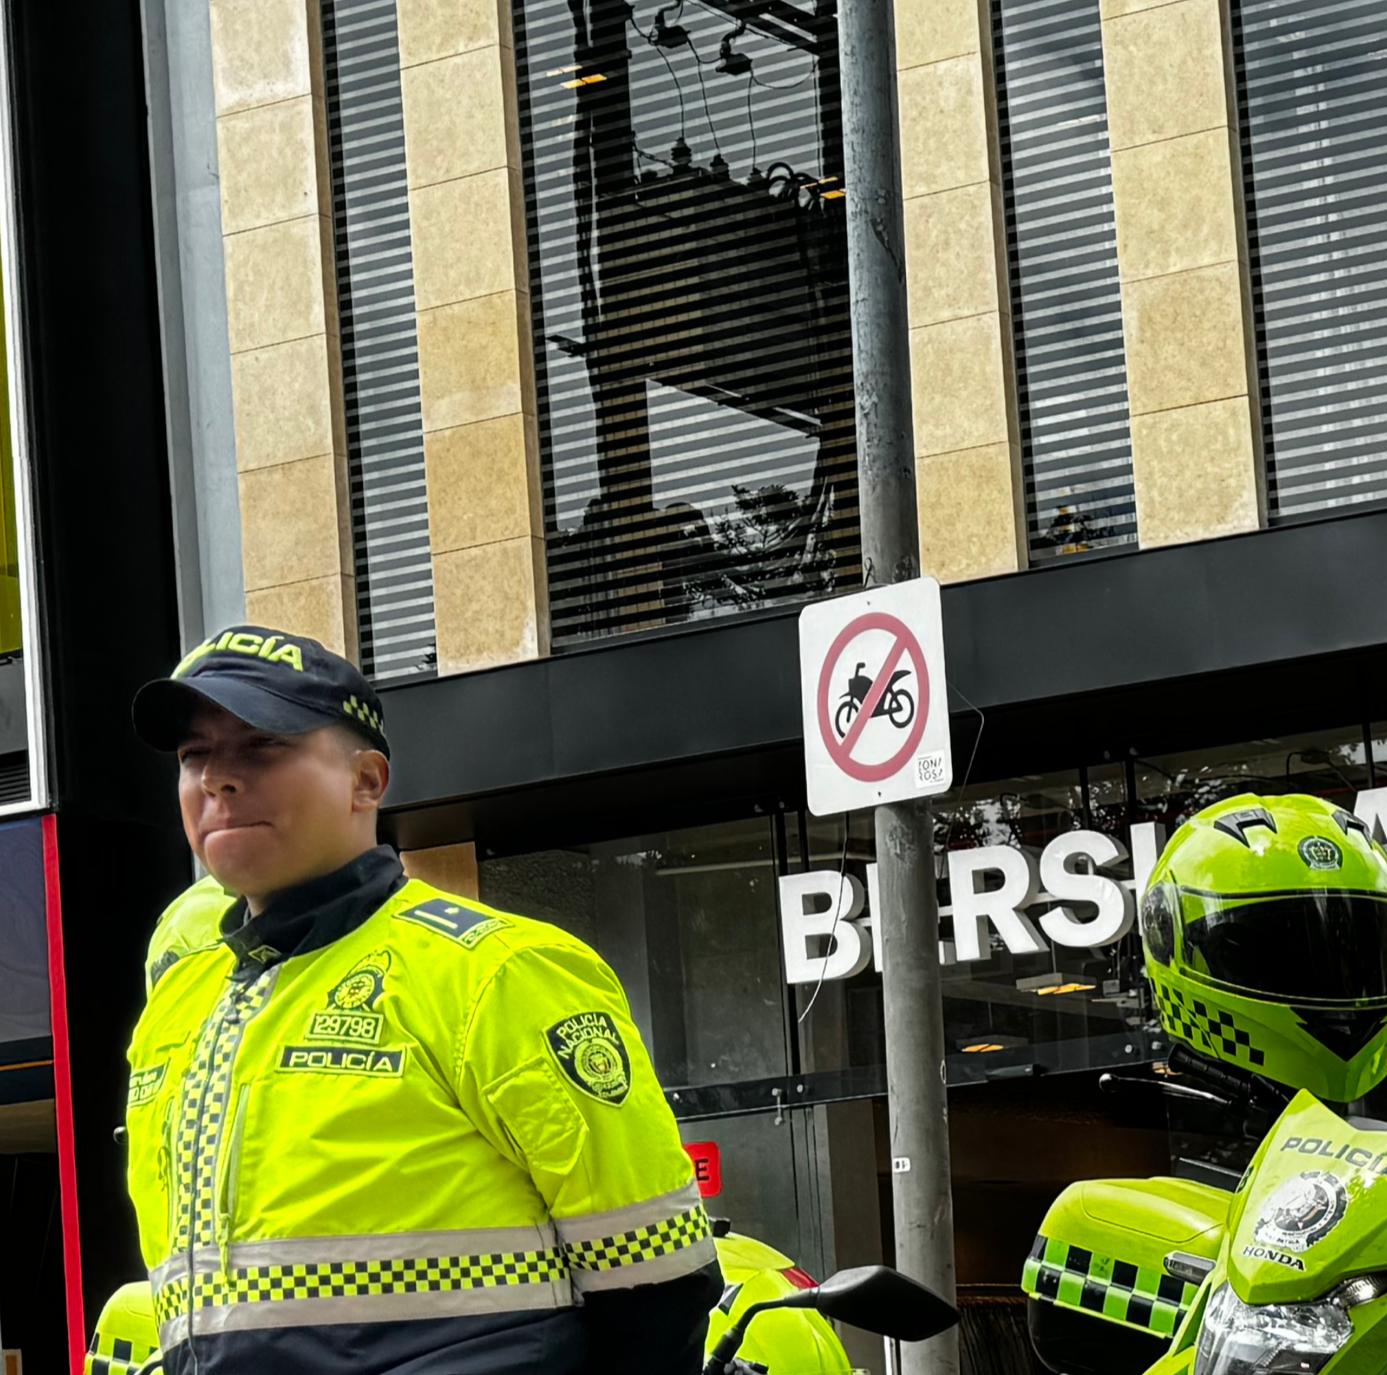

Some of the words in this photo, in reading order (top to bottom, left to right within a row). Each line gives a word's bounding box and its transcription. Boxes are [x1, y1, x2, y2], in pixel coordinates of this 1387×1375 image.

[314, 1014, 377, 1038] 129798
[289, 1051, 394, 1072] POLICÍA
[1243, 1245, 1305, 1272] HONDA
